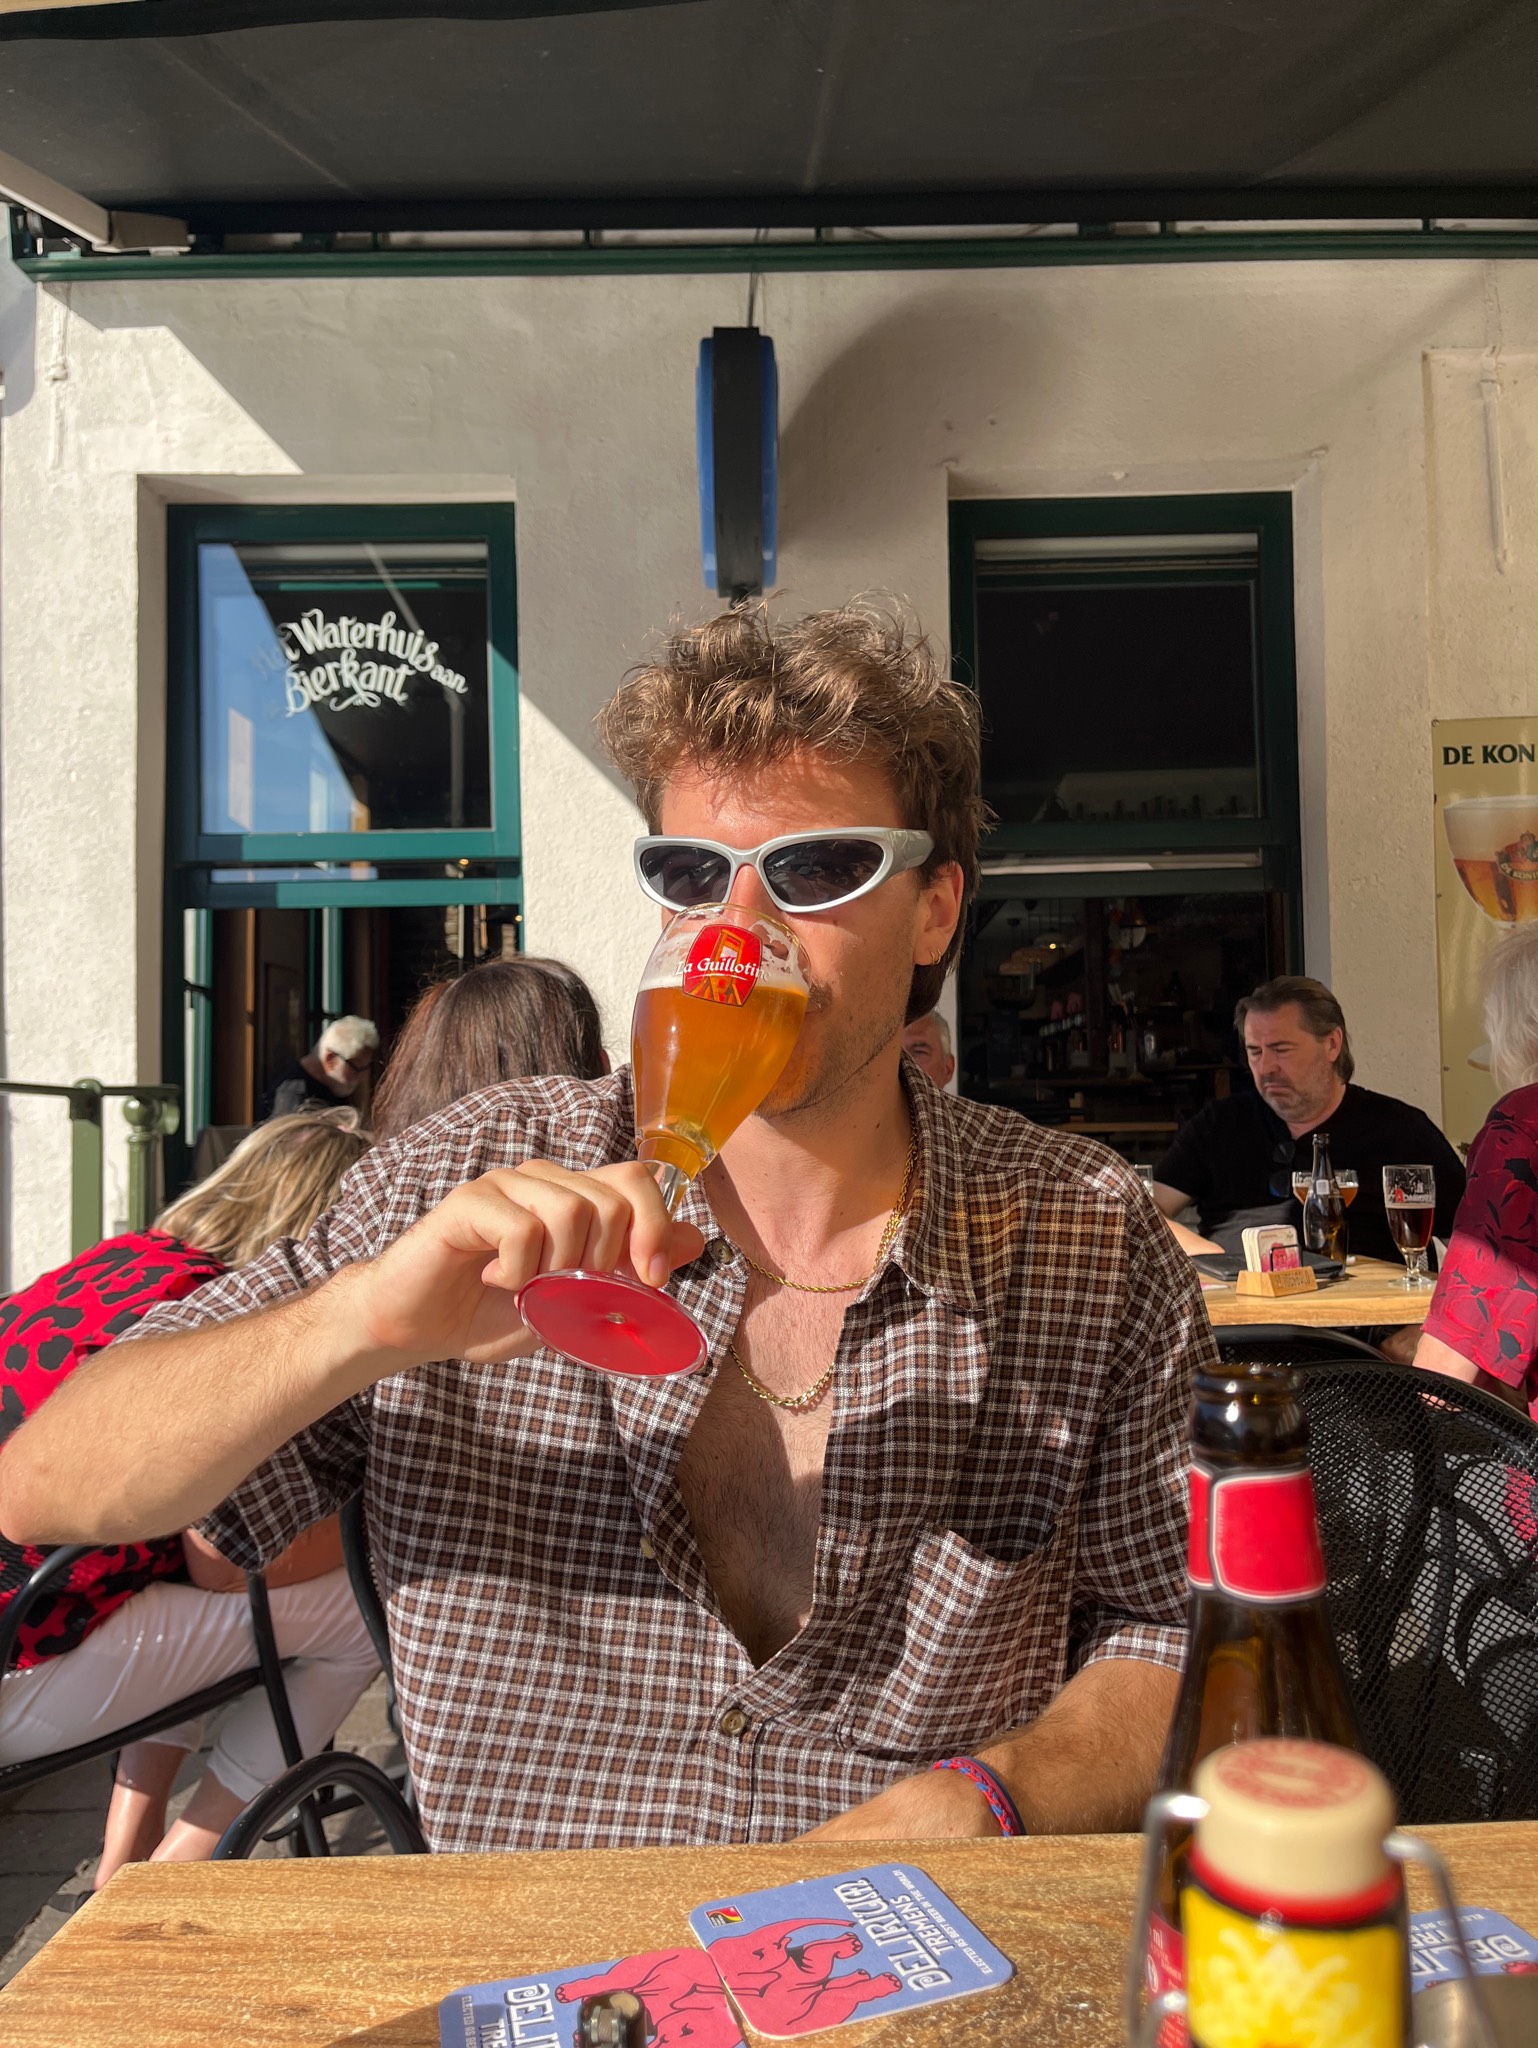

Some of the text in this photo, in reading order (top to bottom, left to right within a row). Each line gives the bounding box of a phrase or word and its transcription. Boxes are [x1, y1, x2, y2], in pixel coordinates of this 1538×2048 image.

[278, 608, 439, 673] Waterhuis
[430, 662, 469, 694] aan
[285, 648, 417, 718] Bierkant
[1443, 743, 1535, 765] DE KON
[673, 957, 769, 982] La Guillotine
[892, 1869, 915, 1890] WORLD!
[910, 1888, 926, 1902] THE
[891, 1894, 953, 1956] TREMENS
[926, 1906, 945, 1924] BEER
[833, 1877, 953, 1992] DELIRIUM
[940, 1922, 960, 1939] BEST
[963, 1947, 993, 1975] ELECTED
[461, 1995, 474, 2026] ELECTED
